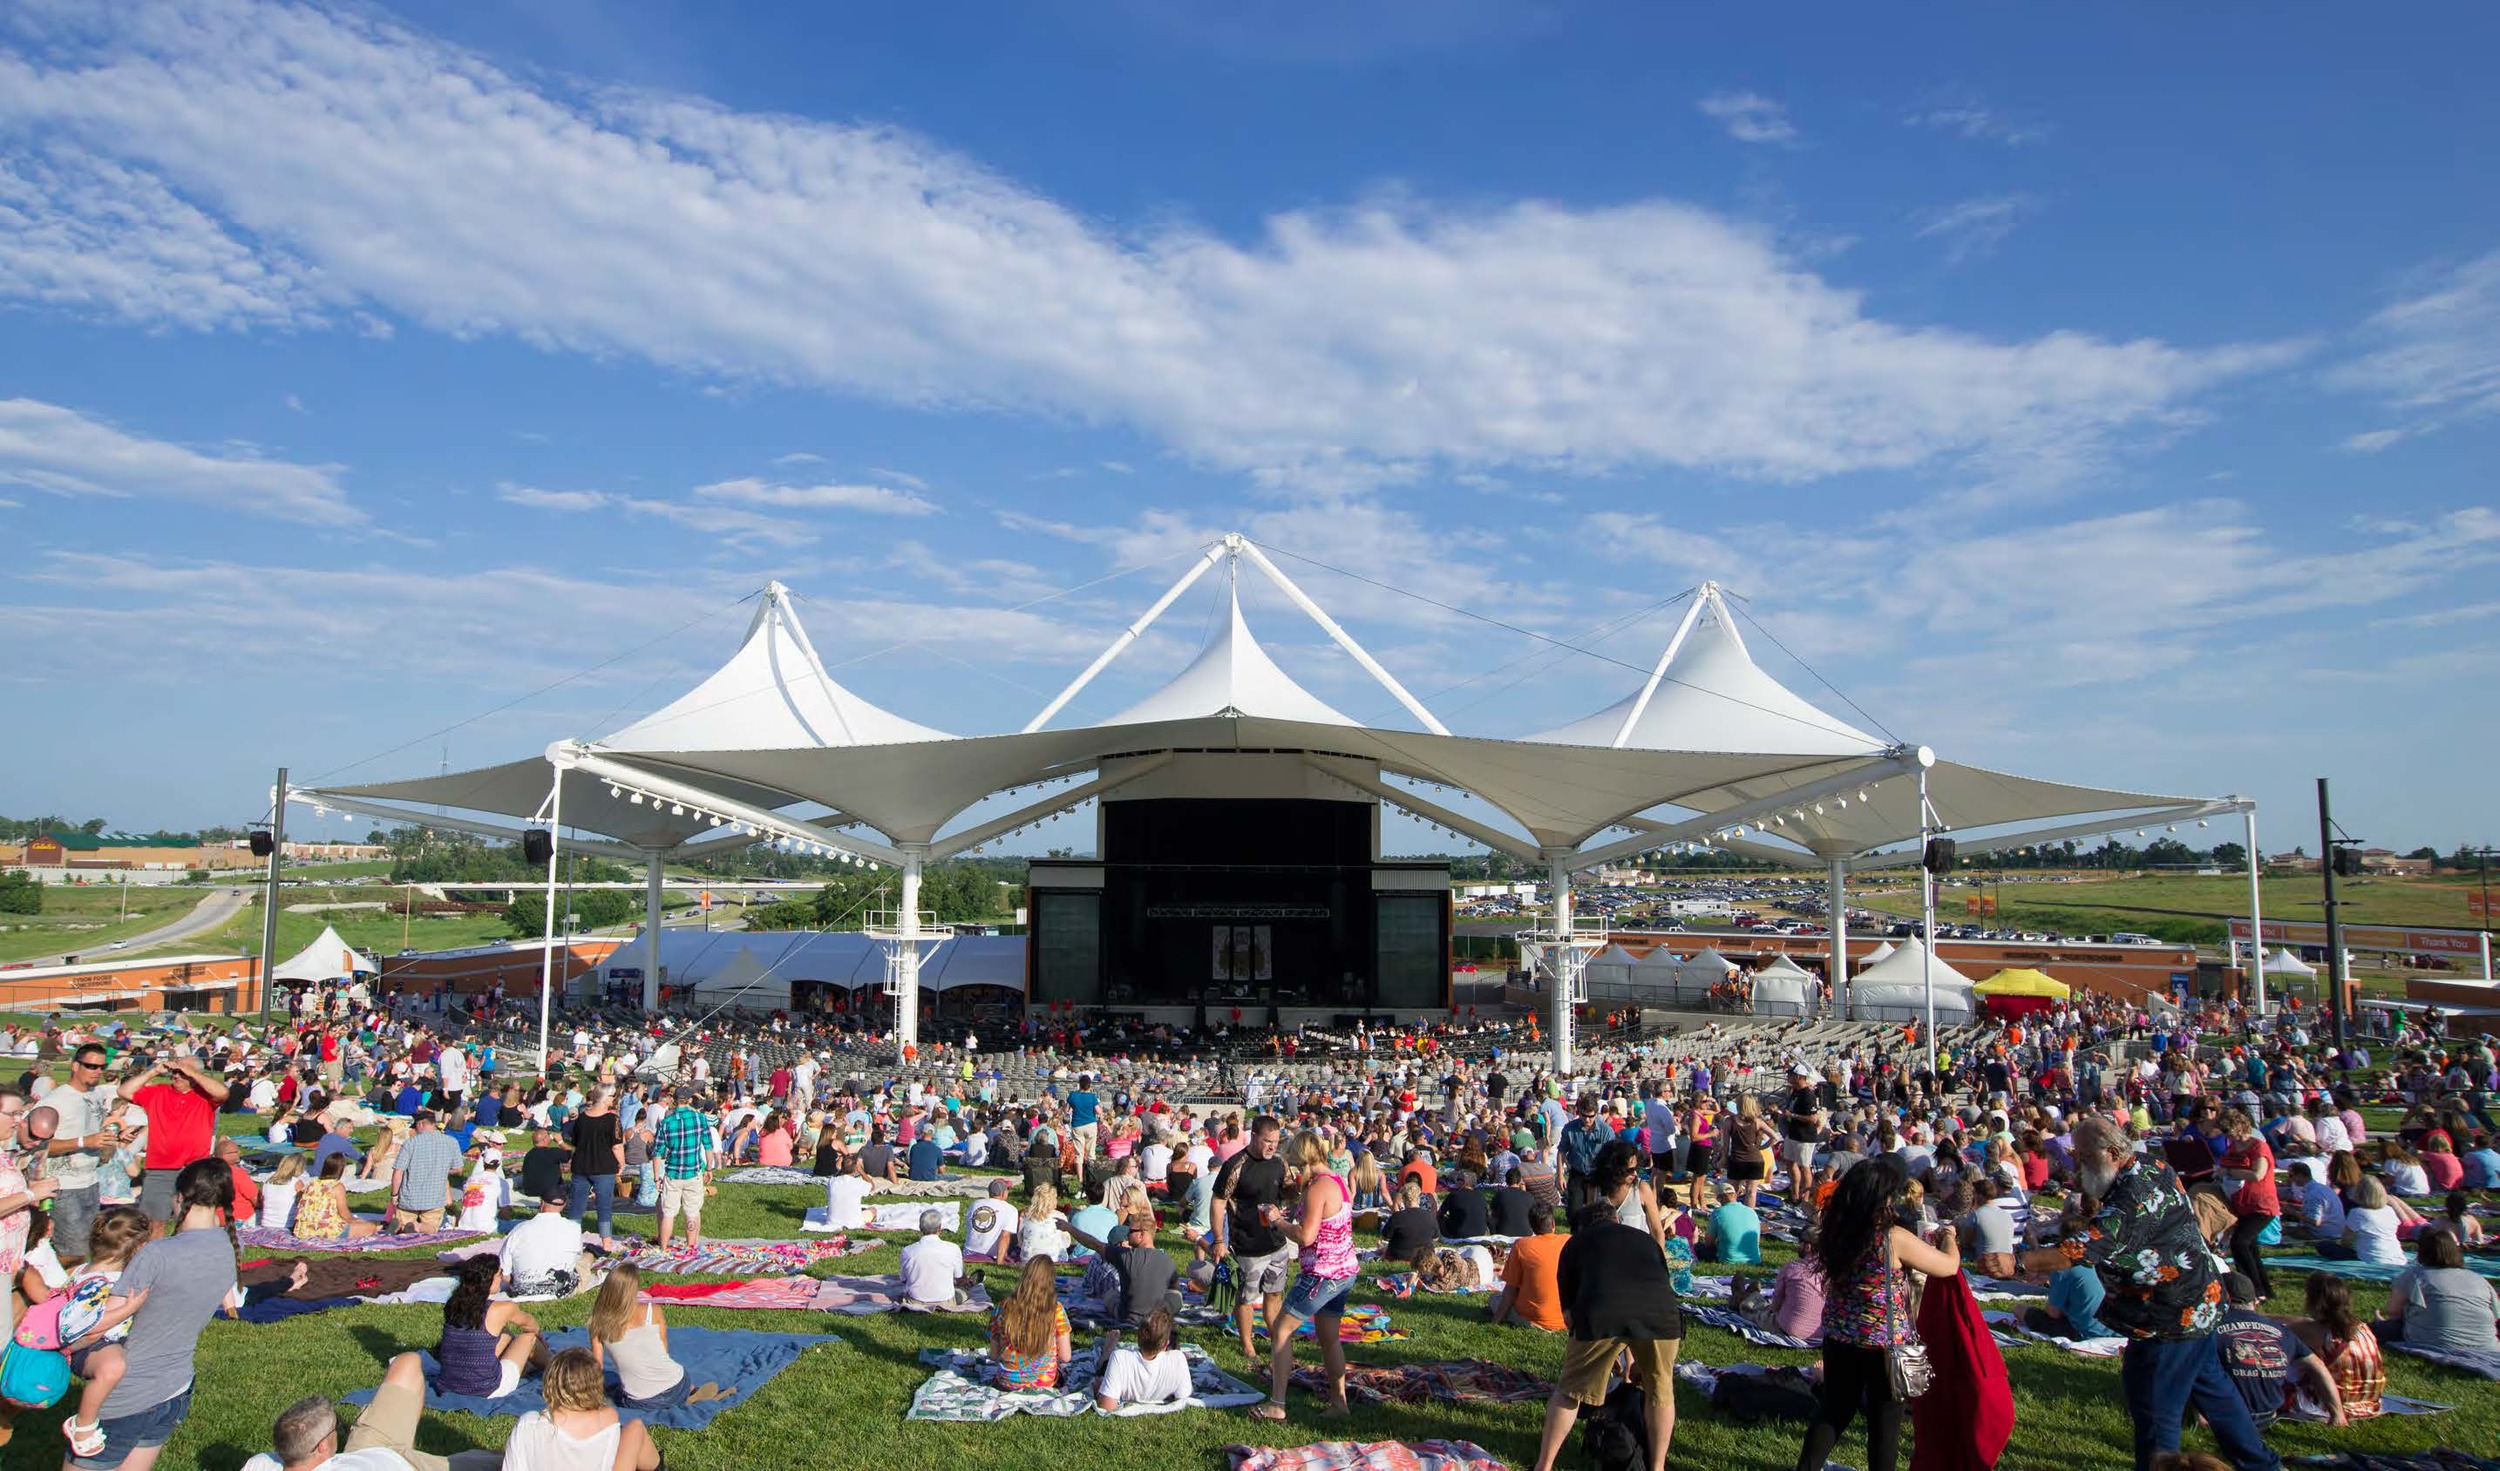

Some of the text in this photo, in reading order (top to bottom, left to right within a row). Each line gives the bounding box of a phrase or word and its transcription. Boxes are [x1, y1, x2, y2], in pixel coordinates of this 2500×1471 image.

[2421, 937, 2468, 948] Thank You
[2232, 1368, 2260, 1377] DRAG
